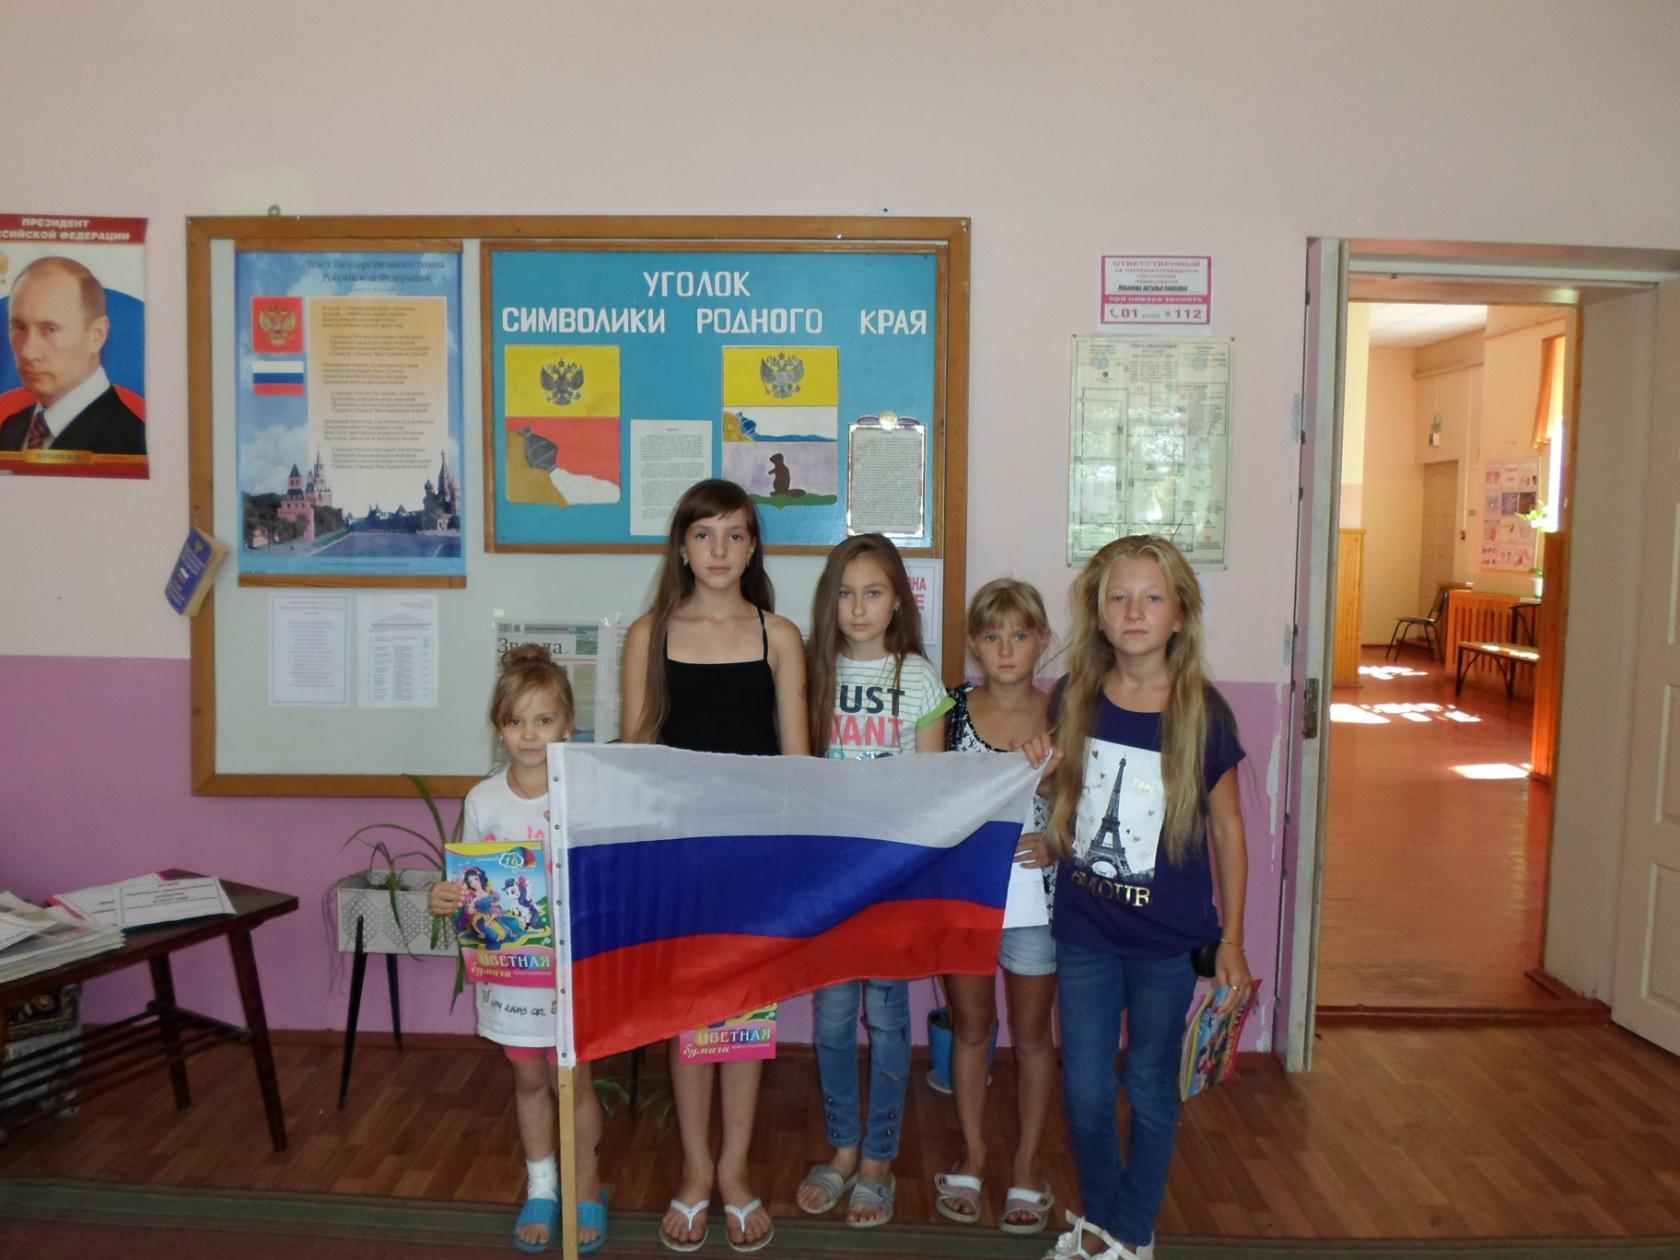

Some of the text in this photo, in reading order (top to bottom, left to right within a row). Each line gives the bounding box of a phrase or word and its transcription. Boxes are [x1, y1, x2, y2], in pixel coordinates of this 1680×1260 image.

[22, 218, 90, 228] ПРЕЗИДЕНТ
[59, 232, 131, 241] ФЕДЕРАЦИИ
[643, 271, 751, 297] УГОЛОК
[502, 307, 927, 335] СИМВОЛИКИ РОДНОГО КРАЯ
[1121, 308, 1138, 319] 01
[1174, 309, 1202, 320] 112
[839, 684, 905, 717] UST
[479, 953, 551, 968] ЦВЕТНАЯ
[697, 1028, 771, 1045] ЦВЕТНАЯ
[683, 1043, 730, 1058] бумага
